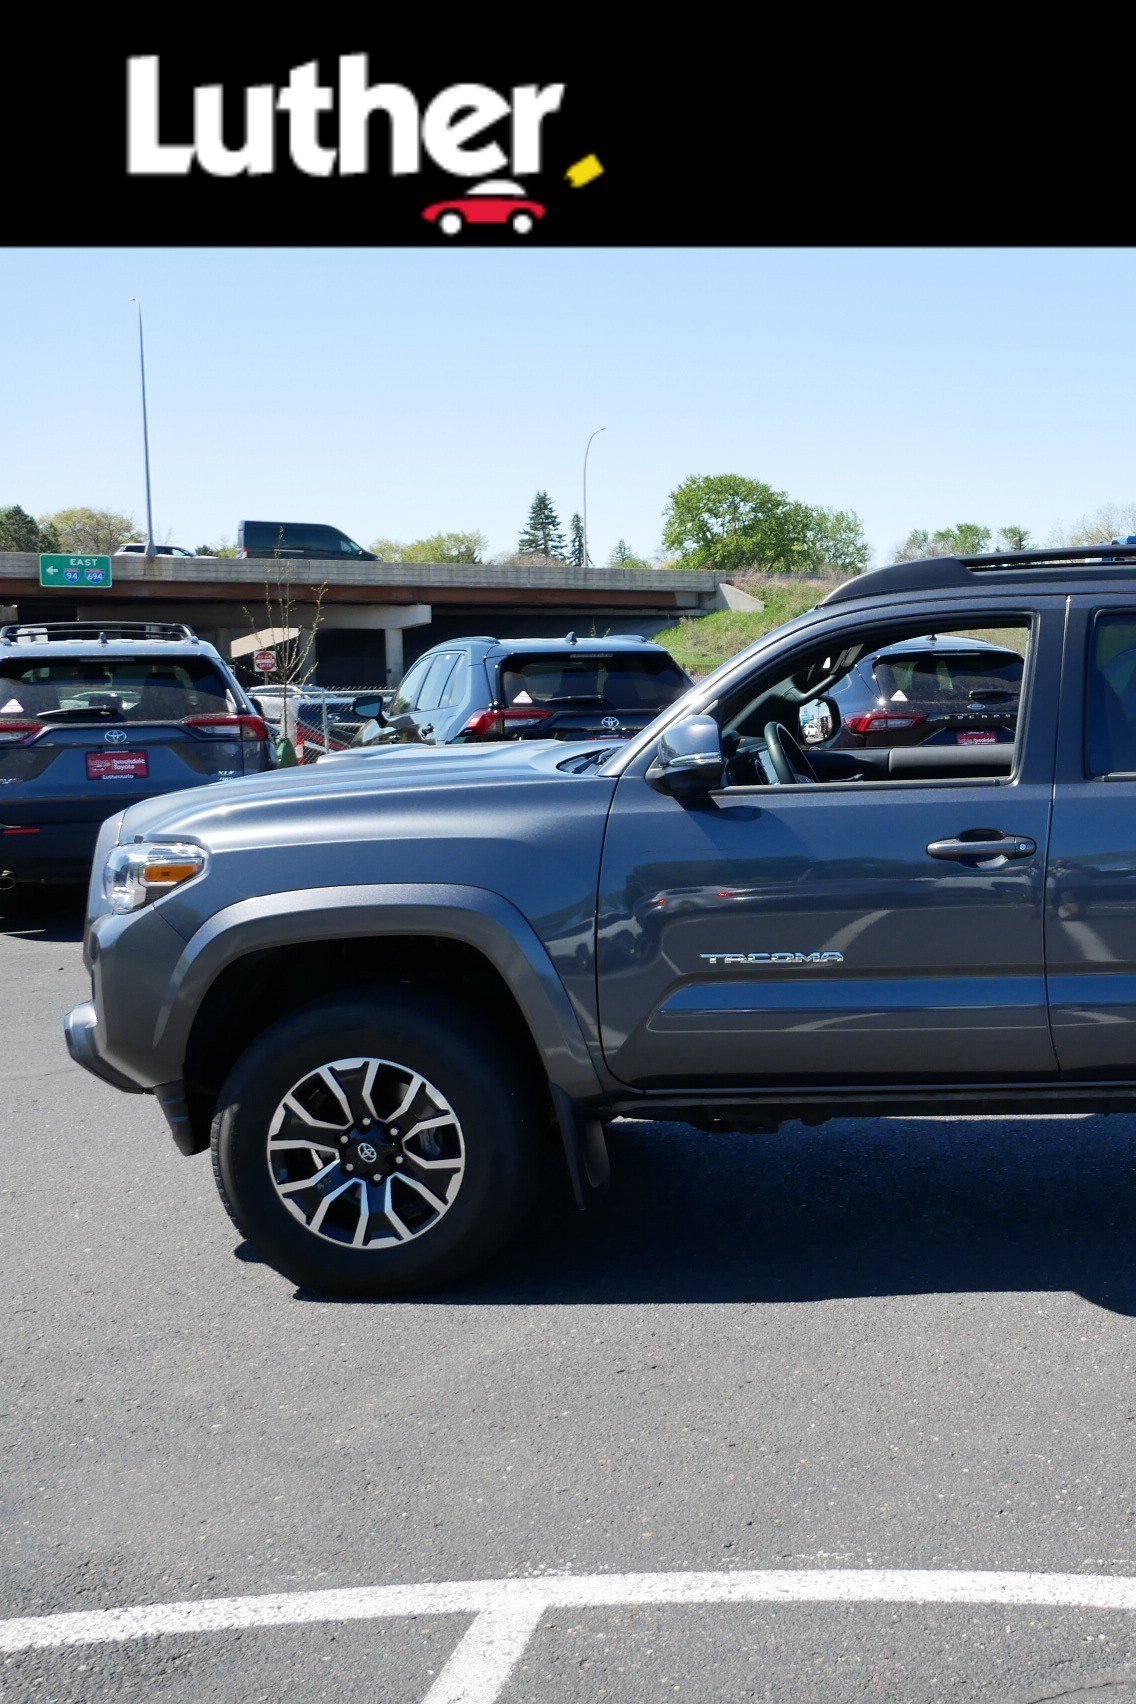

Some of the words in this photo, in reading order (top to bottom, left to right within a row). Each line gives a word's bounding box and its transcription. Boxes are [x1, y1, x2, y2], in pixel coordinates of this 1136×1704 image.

[69, 558, 98, 567] EAST
[66, 572, 78, 580] 94
[87, 572, 103, 581] 694
[699, 952, 845, 964] TACOMA
